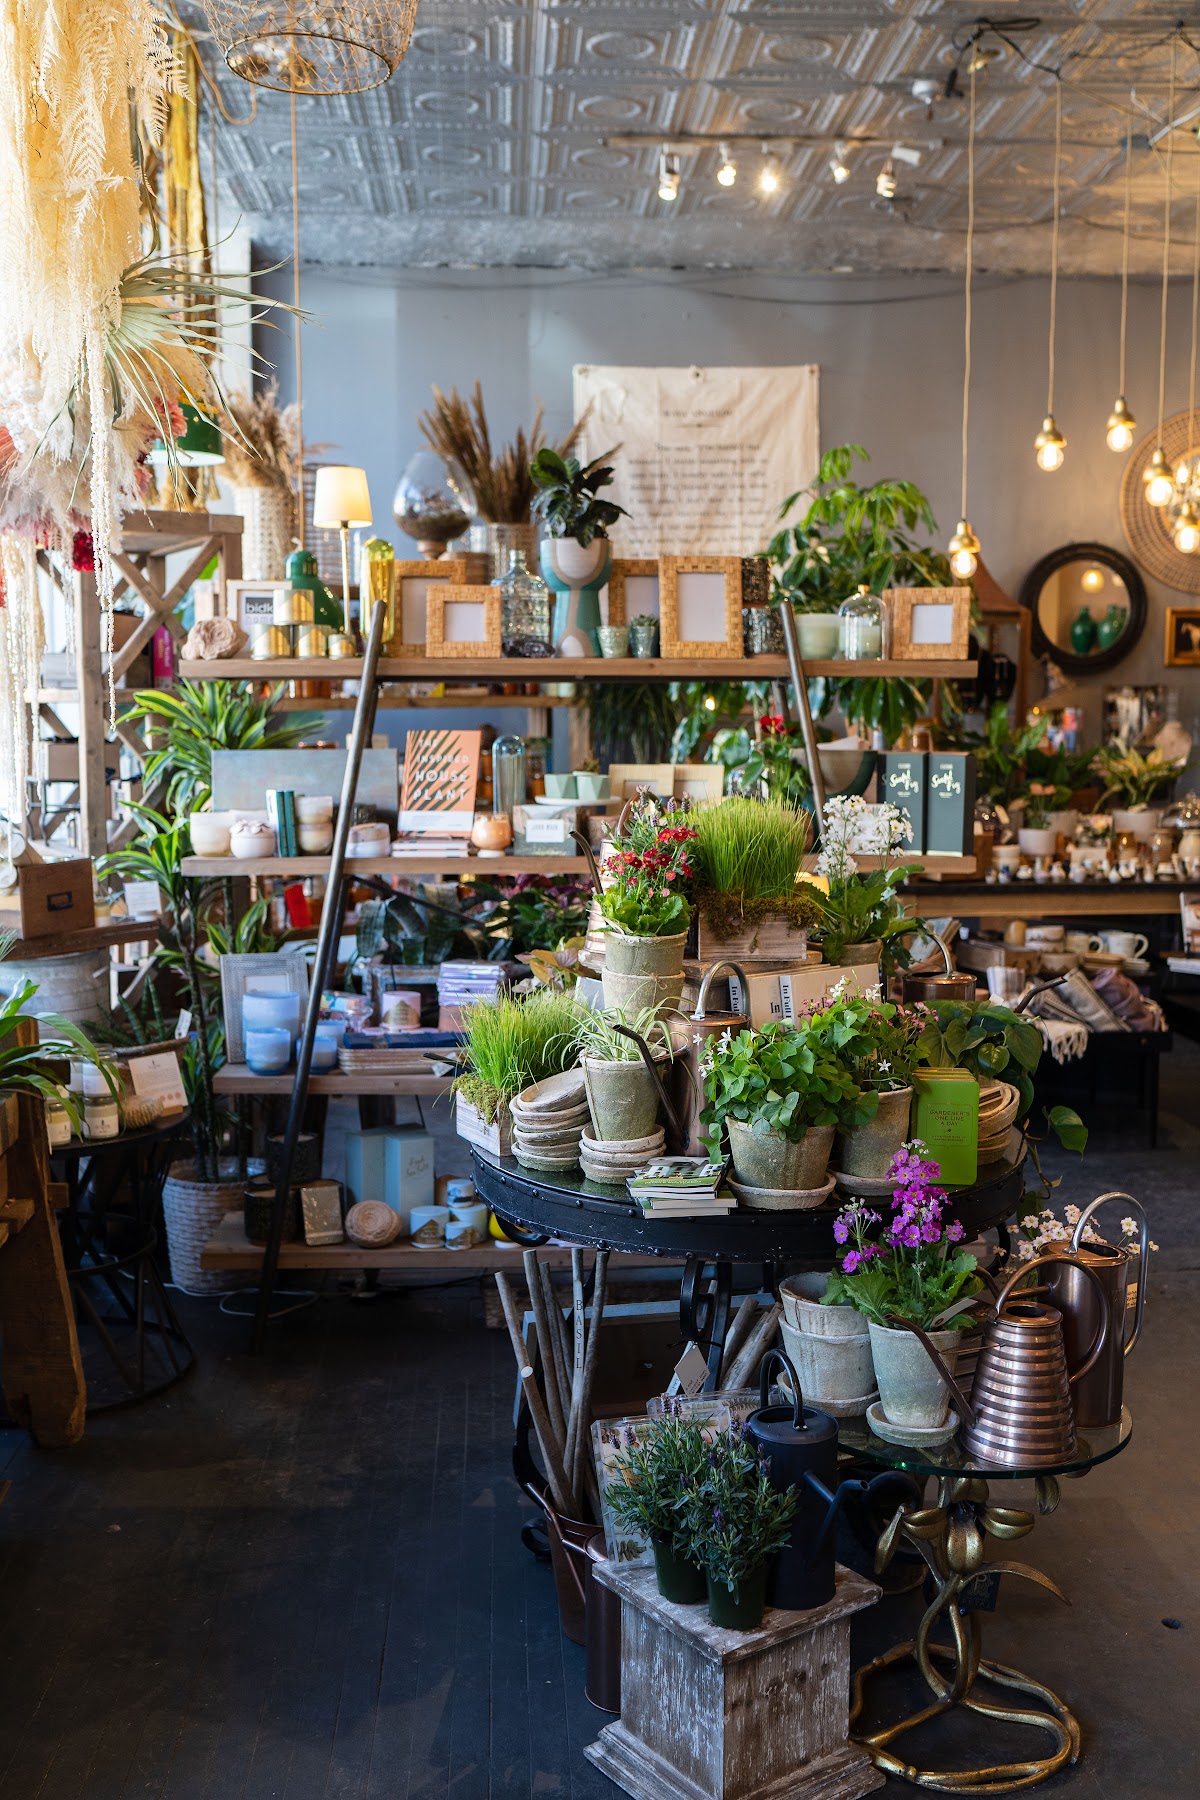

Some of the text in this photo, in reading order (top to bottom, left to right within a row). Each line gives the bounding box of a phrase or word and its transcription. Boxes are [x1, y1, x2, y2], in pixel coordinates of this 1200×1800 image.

[418, 738, 438, 748] THE
[416, 754, 469, 764] INSPIRED
[415, 769, 467, 782] HOUSE
[413, 788, 465, 801] PLANT
[783, 985, 789, 994] In
[731, 986, 740, 1012] In Ful
[784, 996, 792, 1013] Full
[770, 1002, 781, 1014] In
[575, 1299, 583, 1369] BASIL
